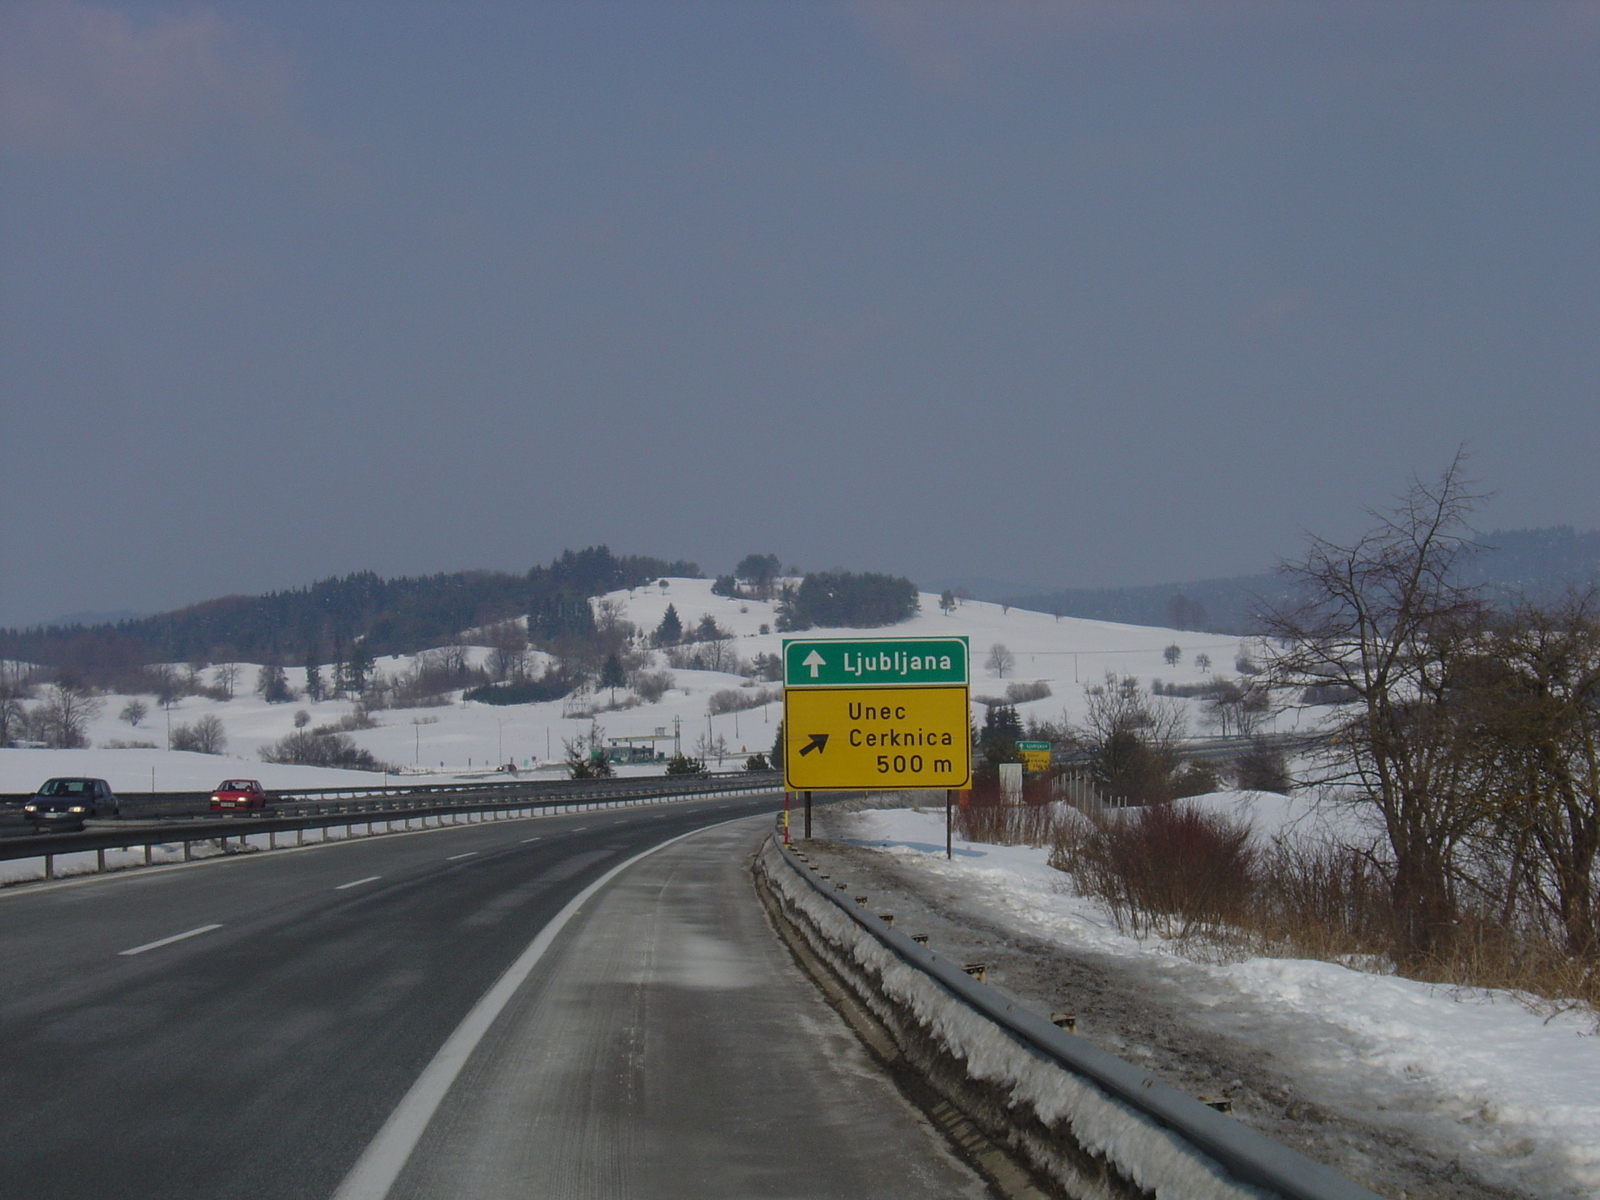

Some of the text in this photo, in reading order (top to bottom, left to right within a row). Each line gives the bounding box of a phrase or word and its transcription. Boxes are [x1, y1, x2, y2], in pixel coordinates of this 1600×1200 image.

[843, 651, 951, 676] Ljubljana
[848, 702, 906, 720] Unec
[849, 728, 952, 747] Cerknica
[877, 755, 952, 773] 500 m
